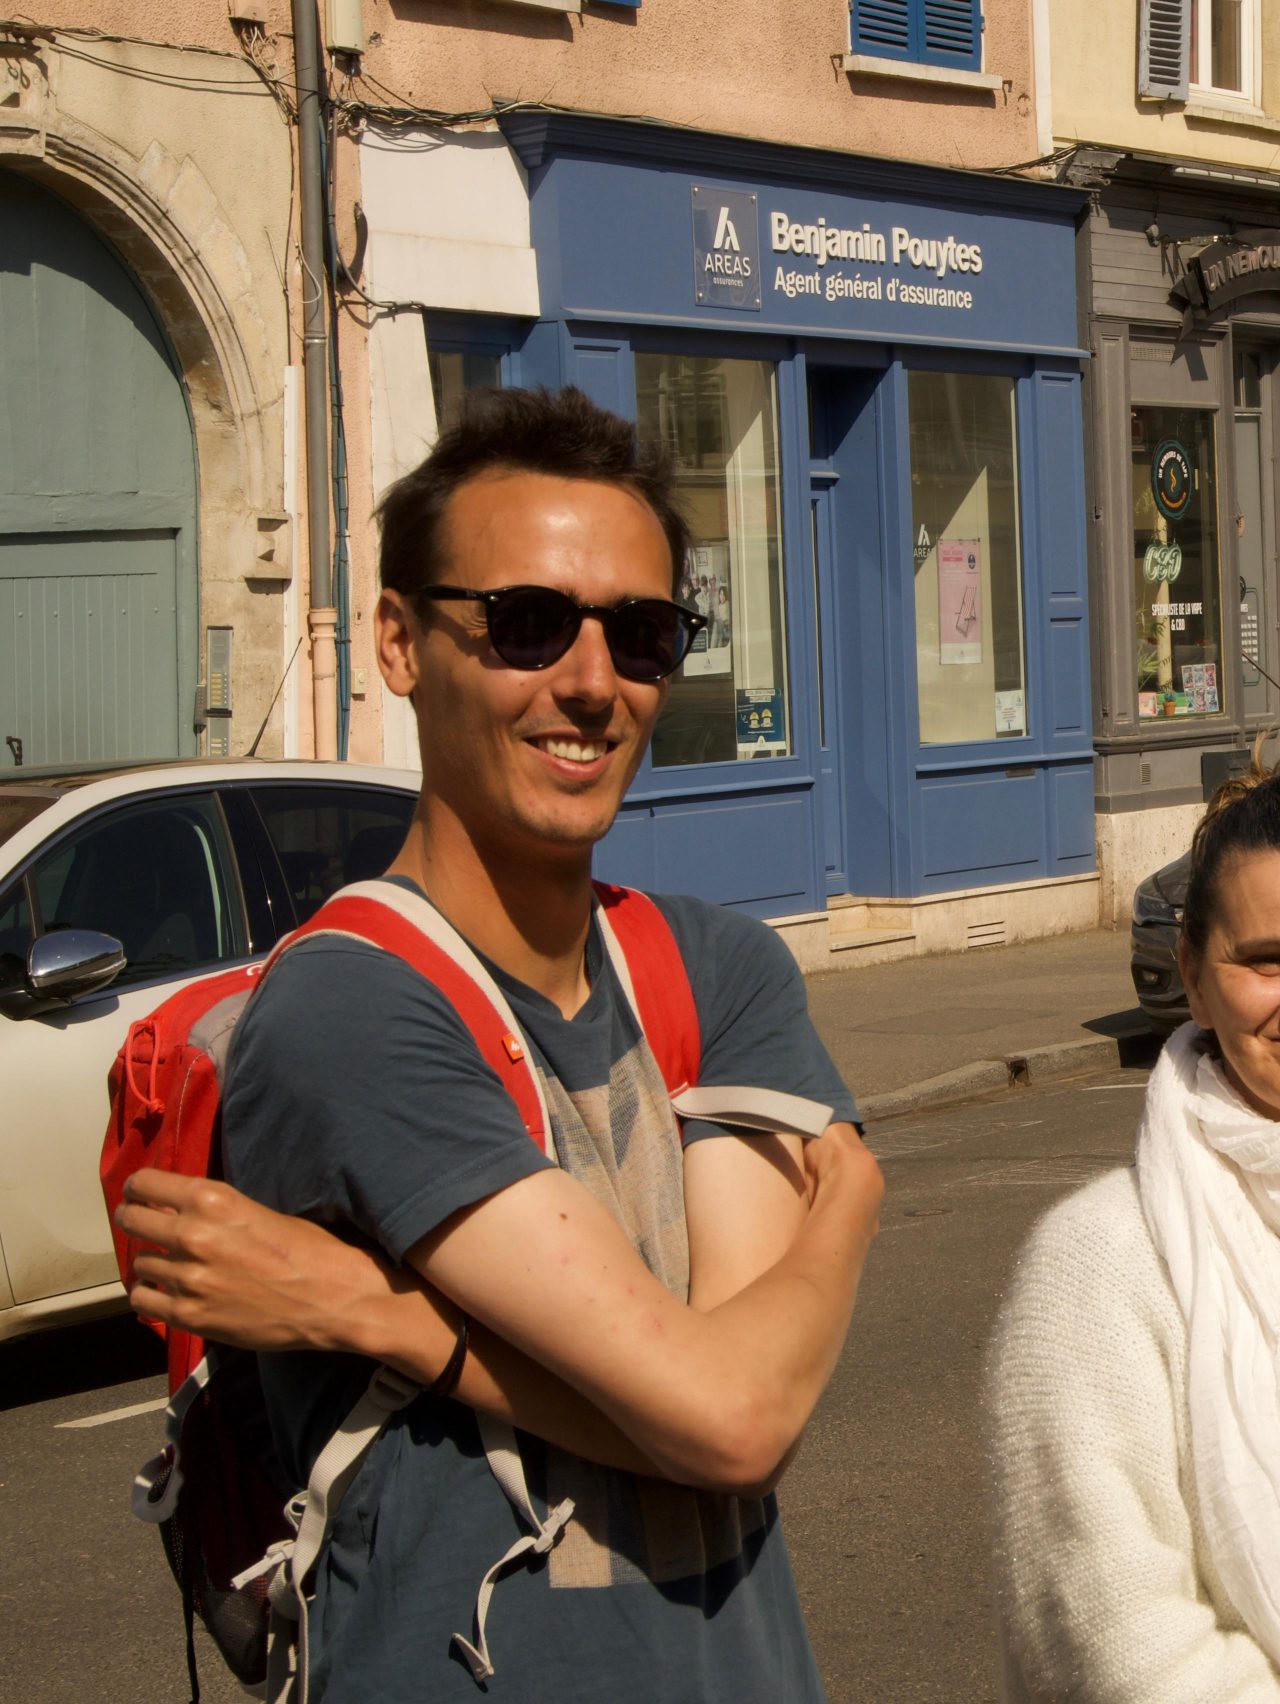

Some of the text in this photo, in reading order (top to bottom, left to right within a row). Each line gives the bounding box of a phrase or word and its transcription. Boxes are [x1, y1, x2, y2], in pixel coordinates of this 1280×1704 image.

[770, 211, 984, 277] Benjamin Pouytes
[704, 252, 752, 277] AREAS
[1202, 260, 1226, 291] UN
[774, 267, 974, 309] Agent général d'assurance
